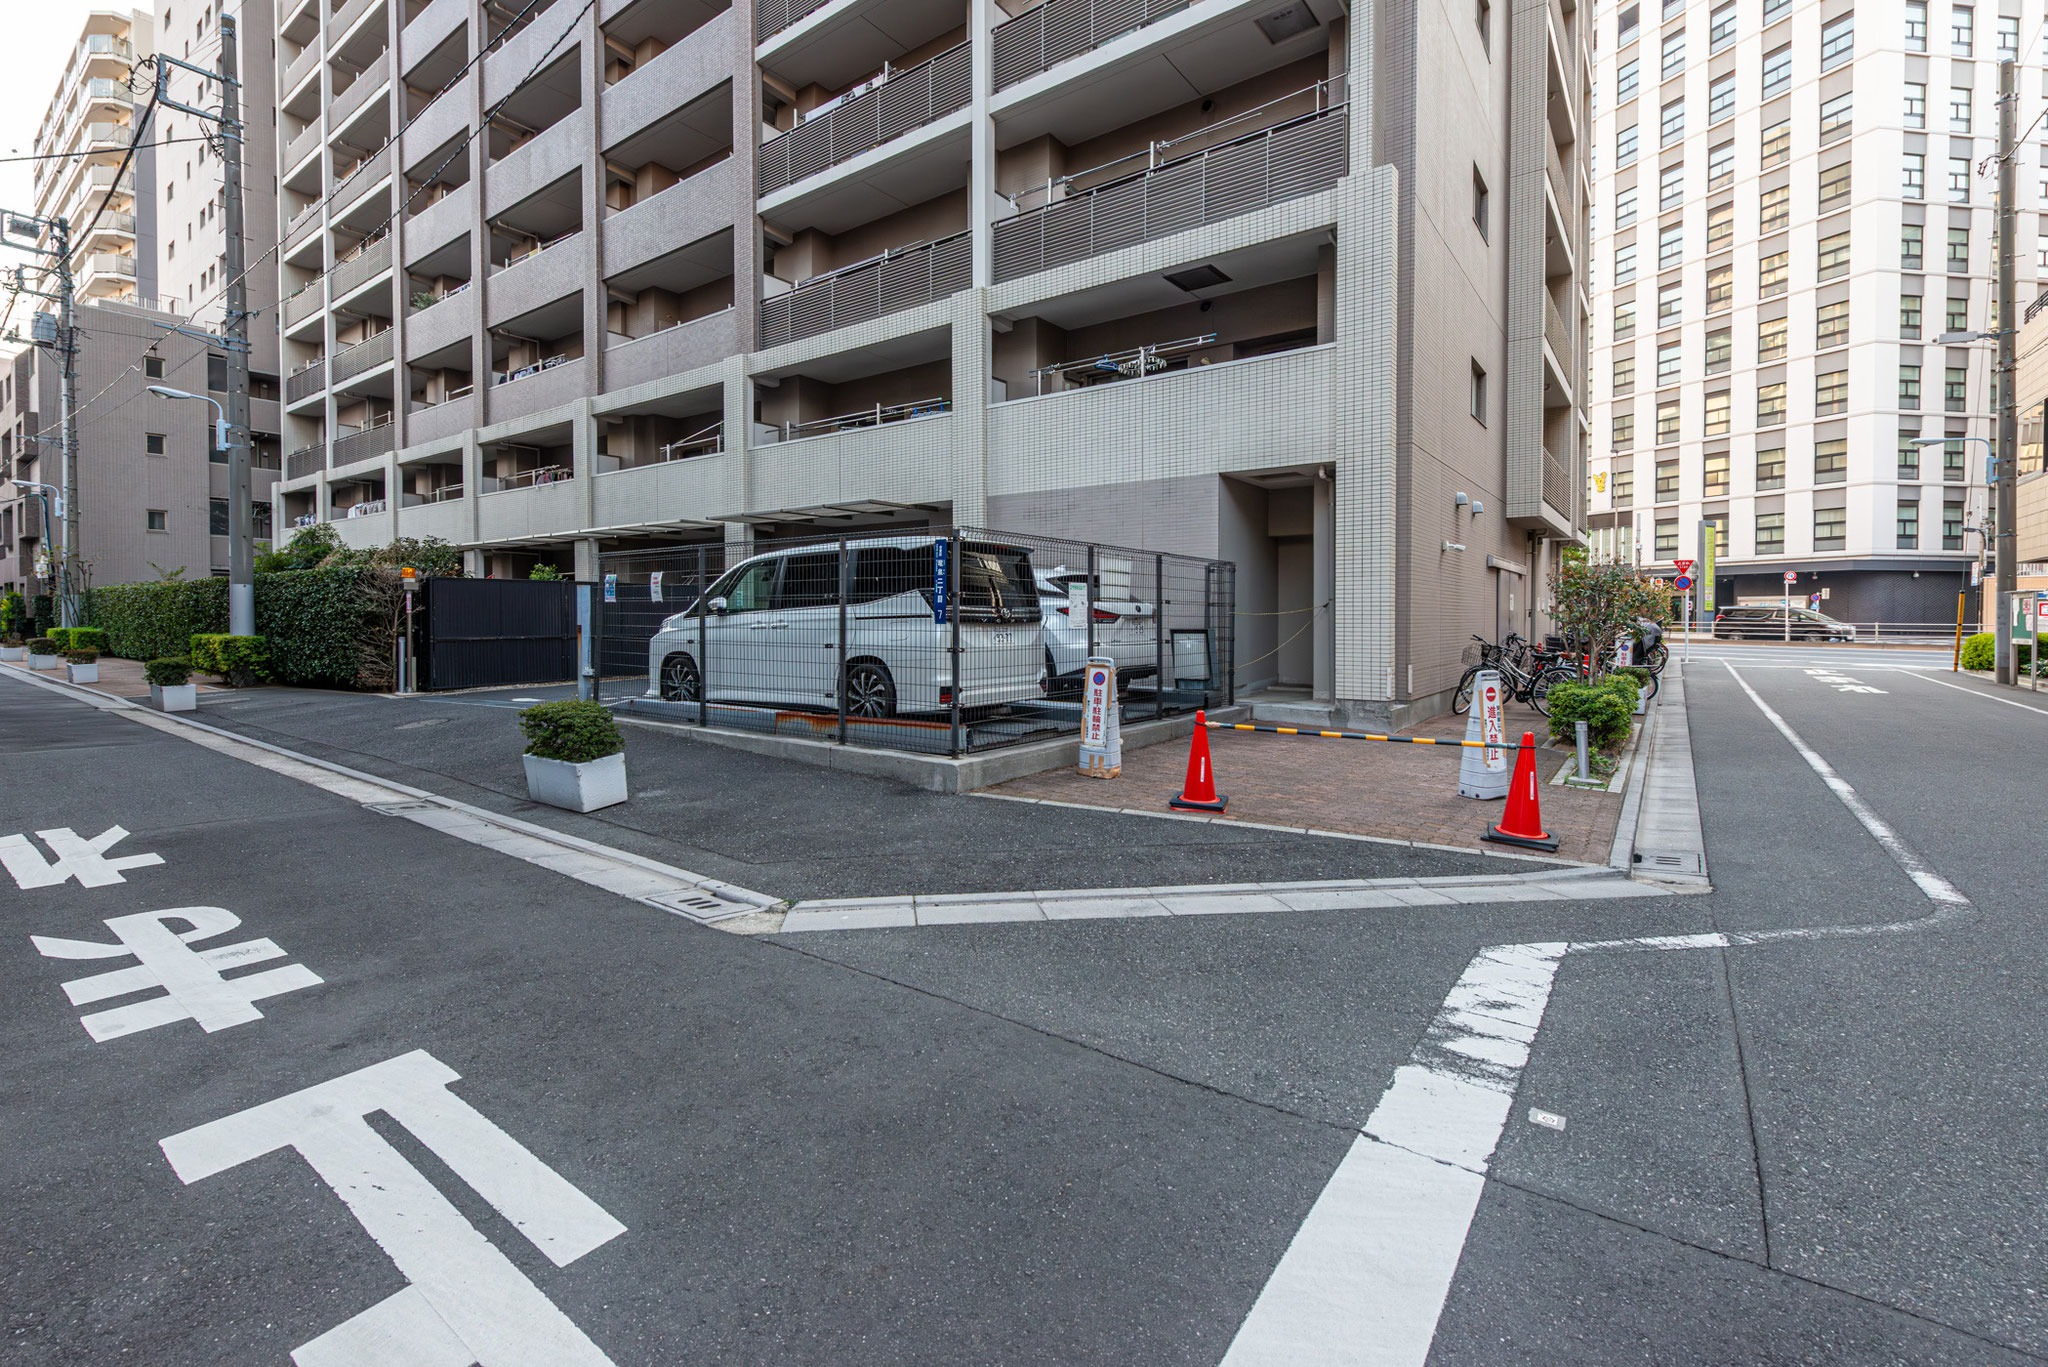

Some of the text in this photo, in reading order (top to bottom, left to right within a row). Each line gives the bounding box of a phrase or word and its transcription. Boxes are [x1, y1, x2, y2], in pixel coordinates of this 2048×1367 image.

[937, 609, 943, 620] 7
[1487, 705, 1499, 761] 進入禁止
